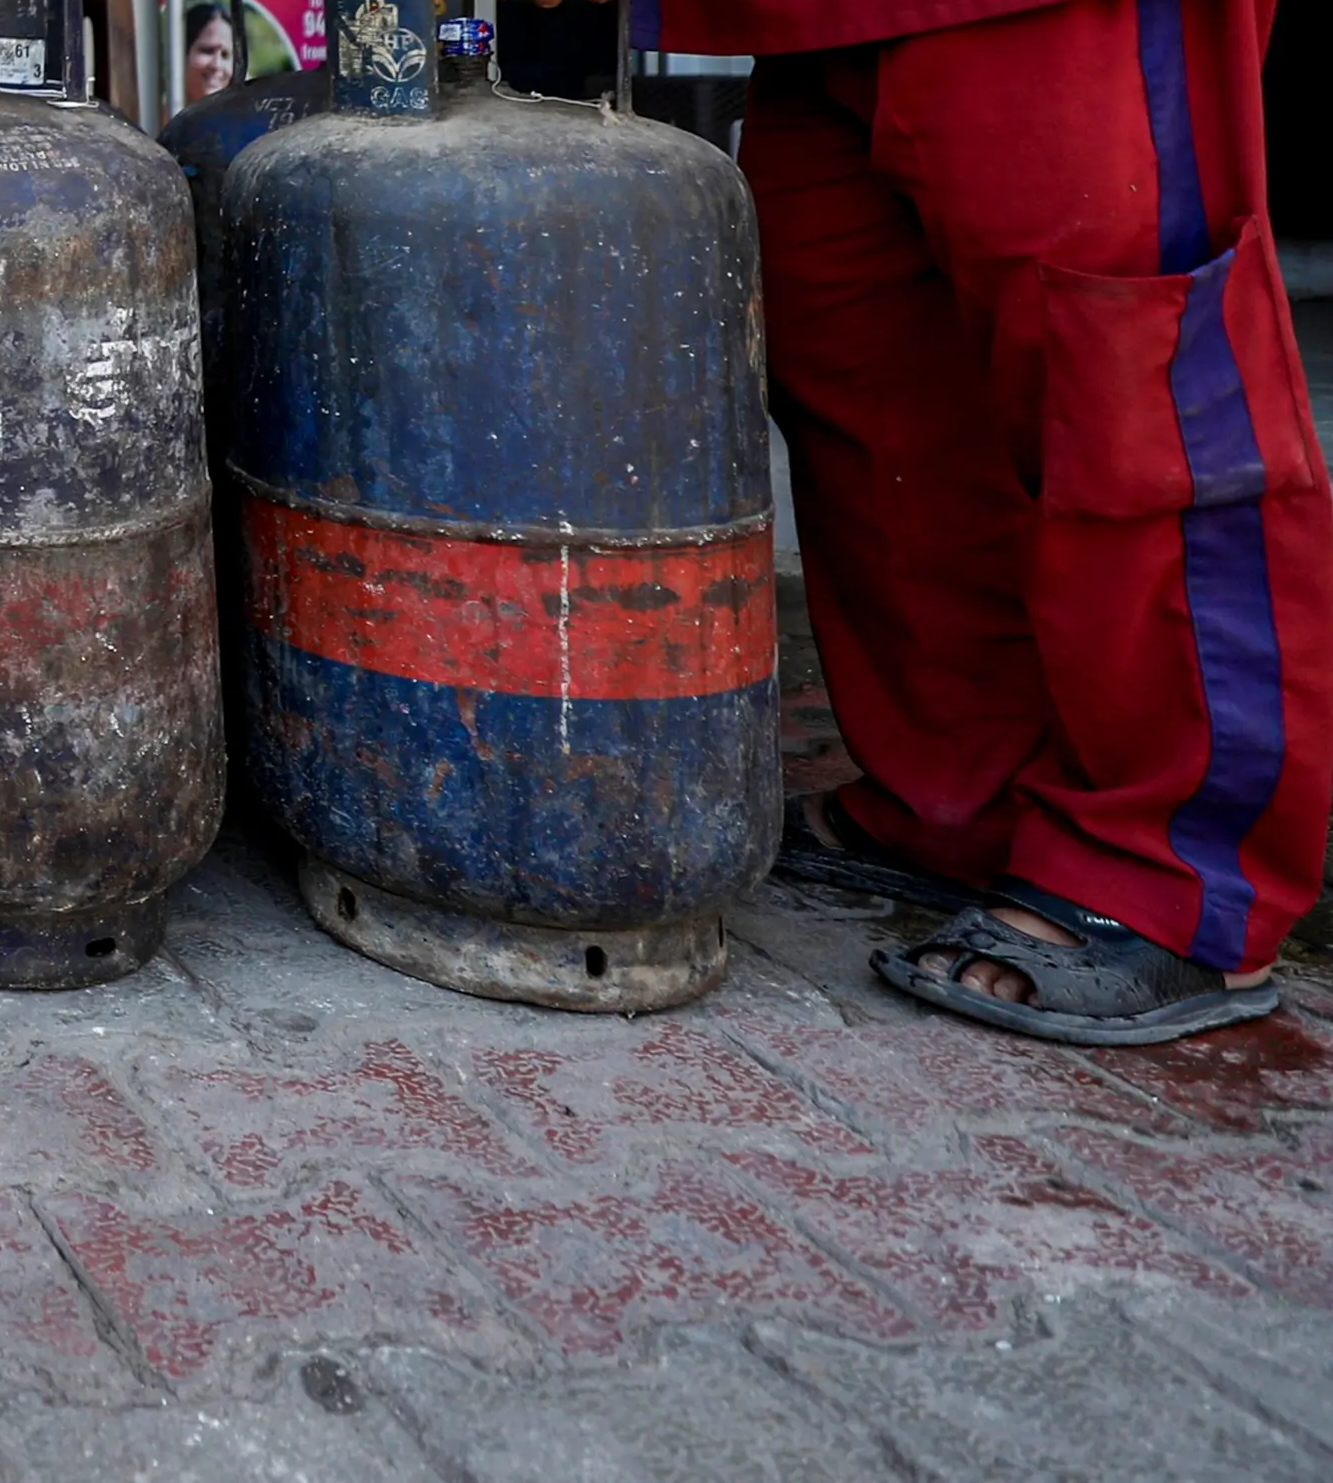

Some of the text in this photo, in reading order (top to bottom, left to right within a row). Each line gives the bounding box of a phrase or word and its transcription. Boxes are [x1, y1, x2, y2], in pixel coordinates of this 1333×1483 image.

[383, 34, 415, 51] HP
[14, 44, 31, 59] 61
[33, 63, 42, 79] 3
[370, 85, 430, 110] GAS
